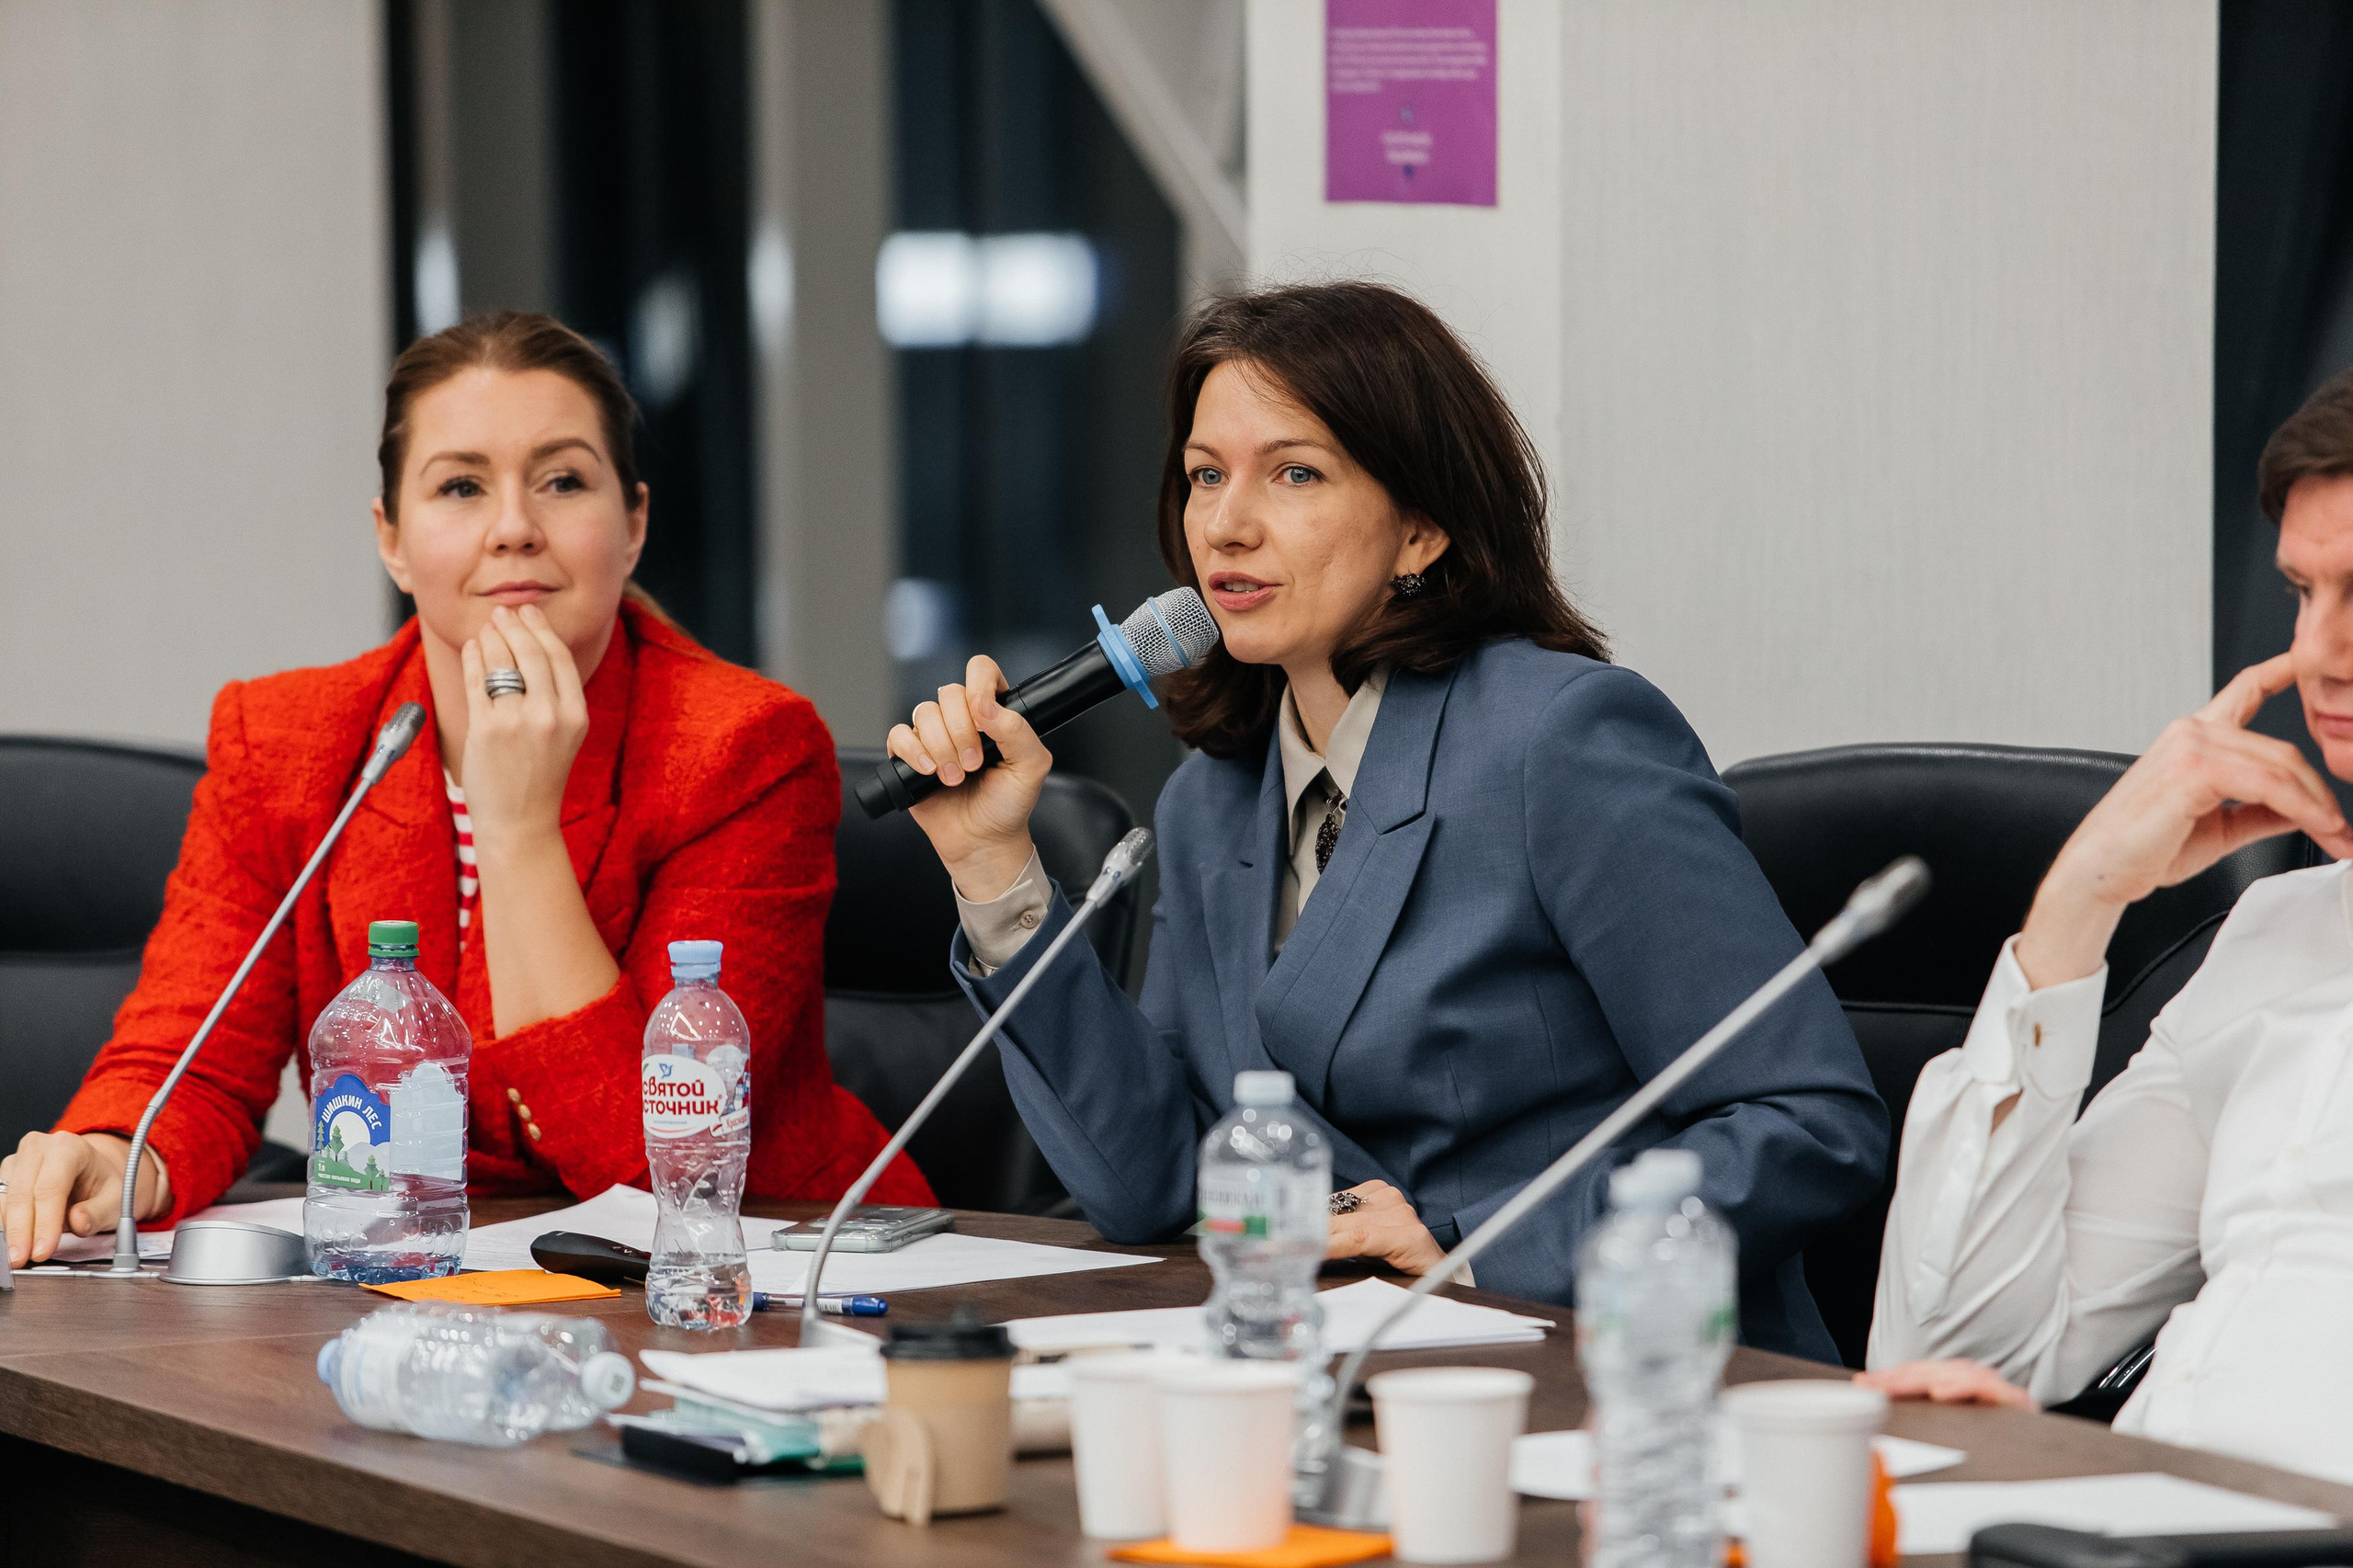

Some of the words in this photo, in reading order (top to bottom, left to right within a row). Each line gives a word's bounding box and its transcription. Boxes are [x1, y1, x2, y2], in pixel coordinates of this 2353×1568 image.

[322, 1095, 363, 1123] ШИШКИН
[362, 1106, 382, 1130] ЛЕС
[643, 1098, 719, 1115] СТОЧНИК
